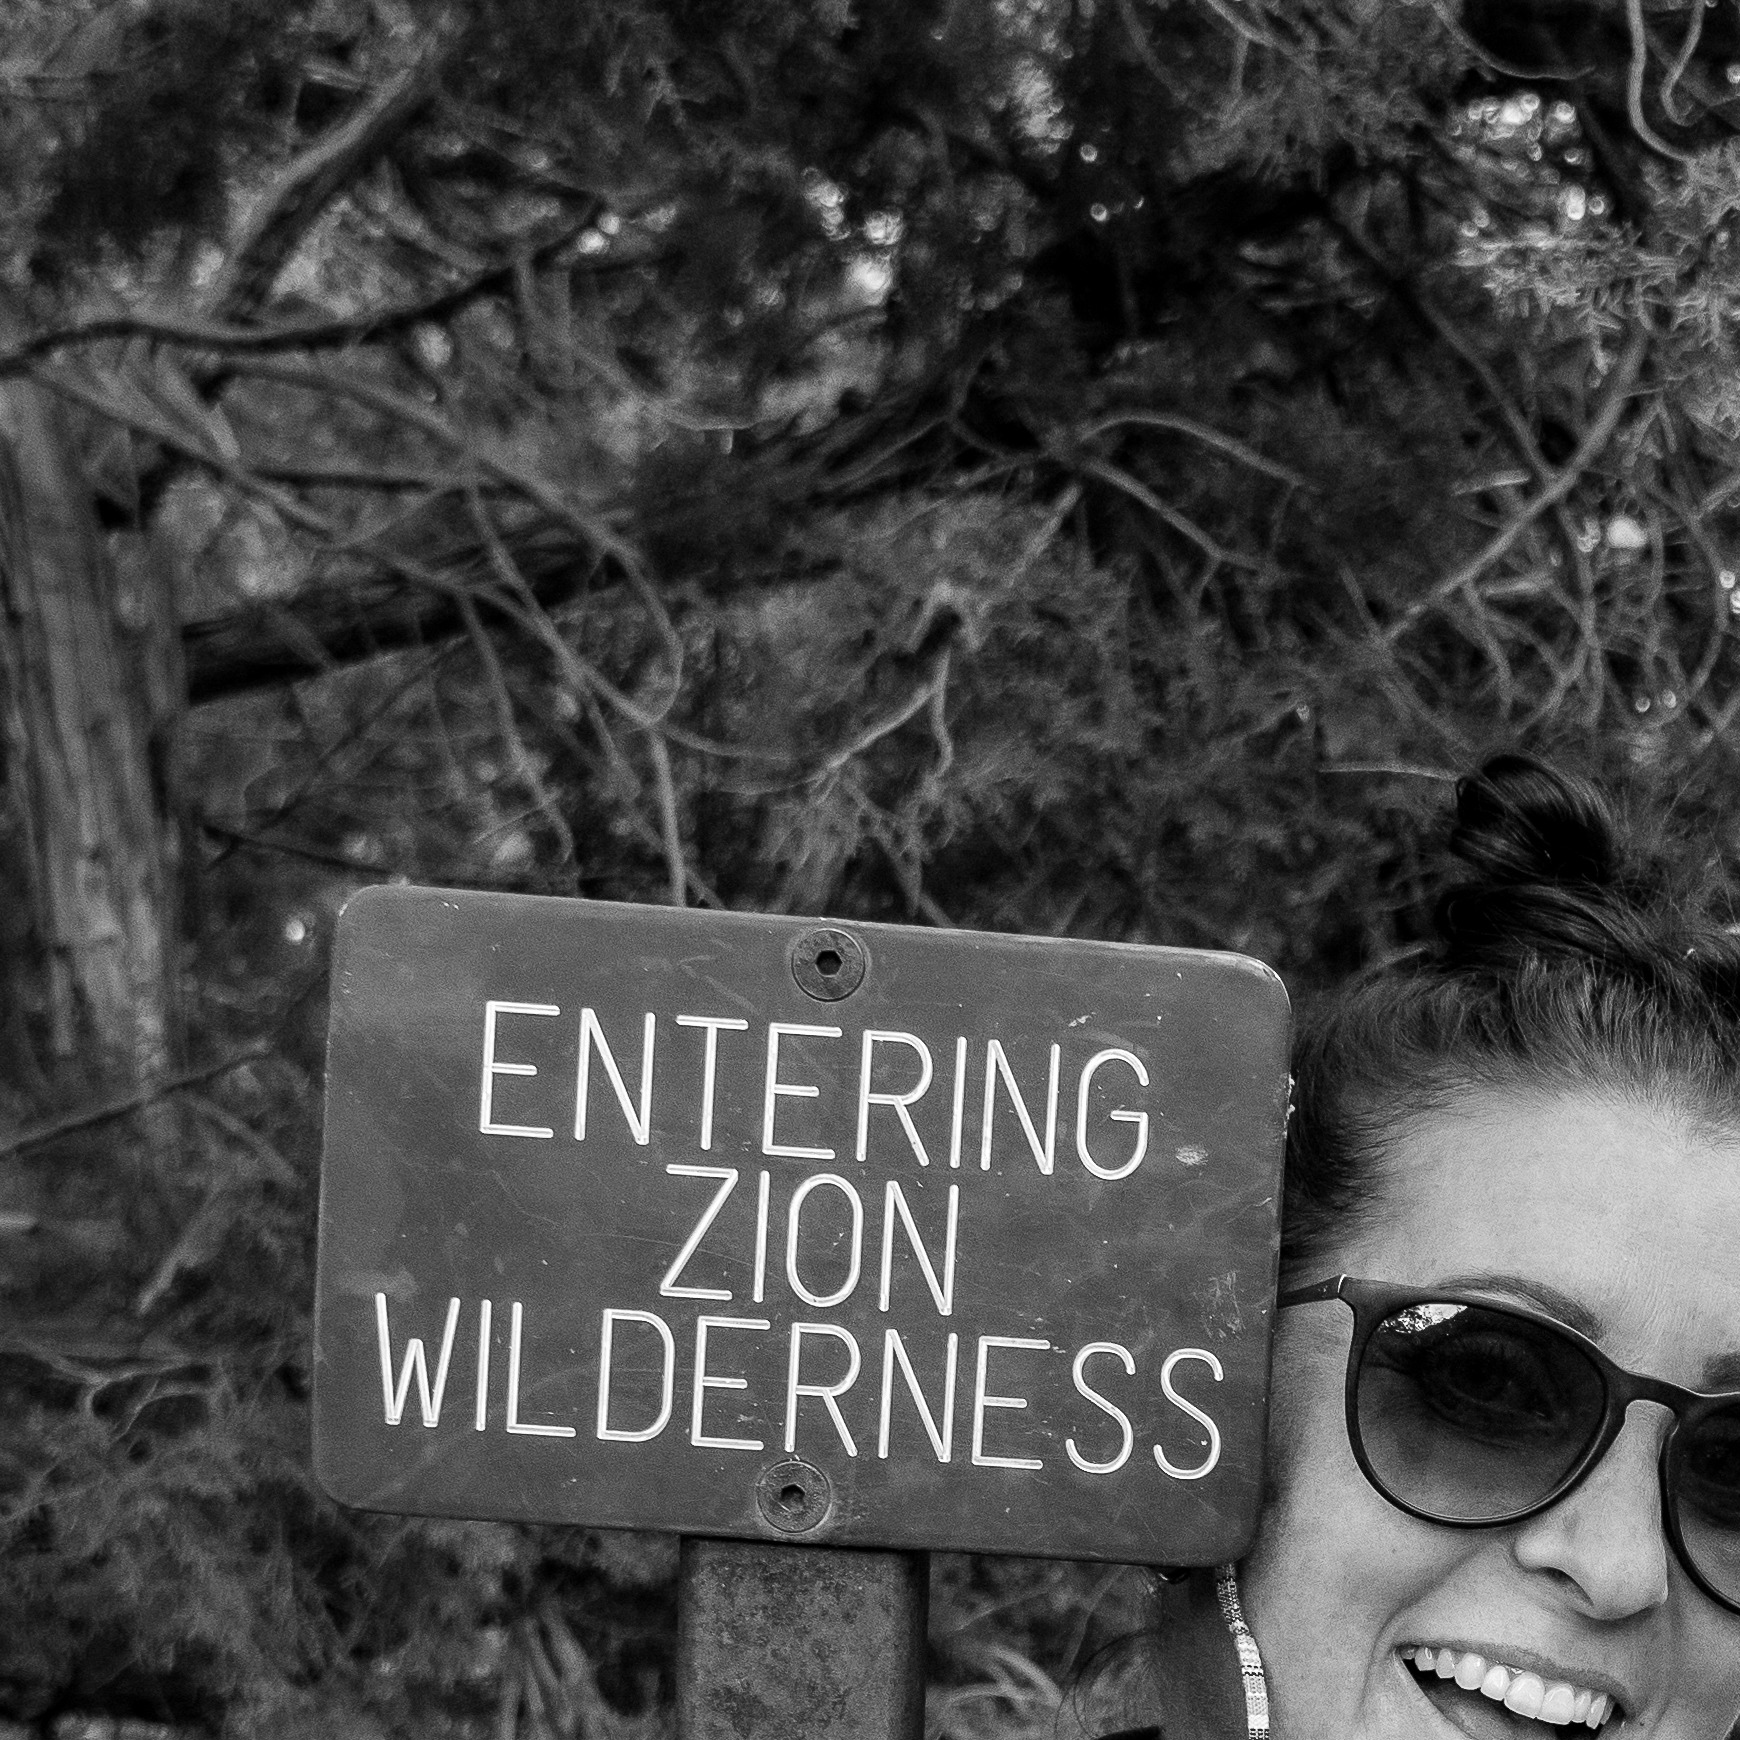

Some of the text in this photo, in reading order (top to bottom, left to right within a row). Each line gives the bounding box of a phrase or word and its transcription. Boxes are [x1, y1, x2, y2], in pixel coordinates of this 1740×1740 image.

[478, 998, 1151, 1182] ENTERING
[658, 1162, 961, 1318] ZION
[373, 1291, 1225, 1481] WILDERNESS
